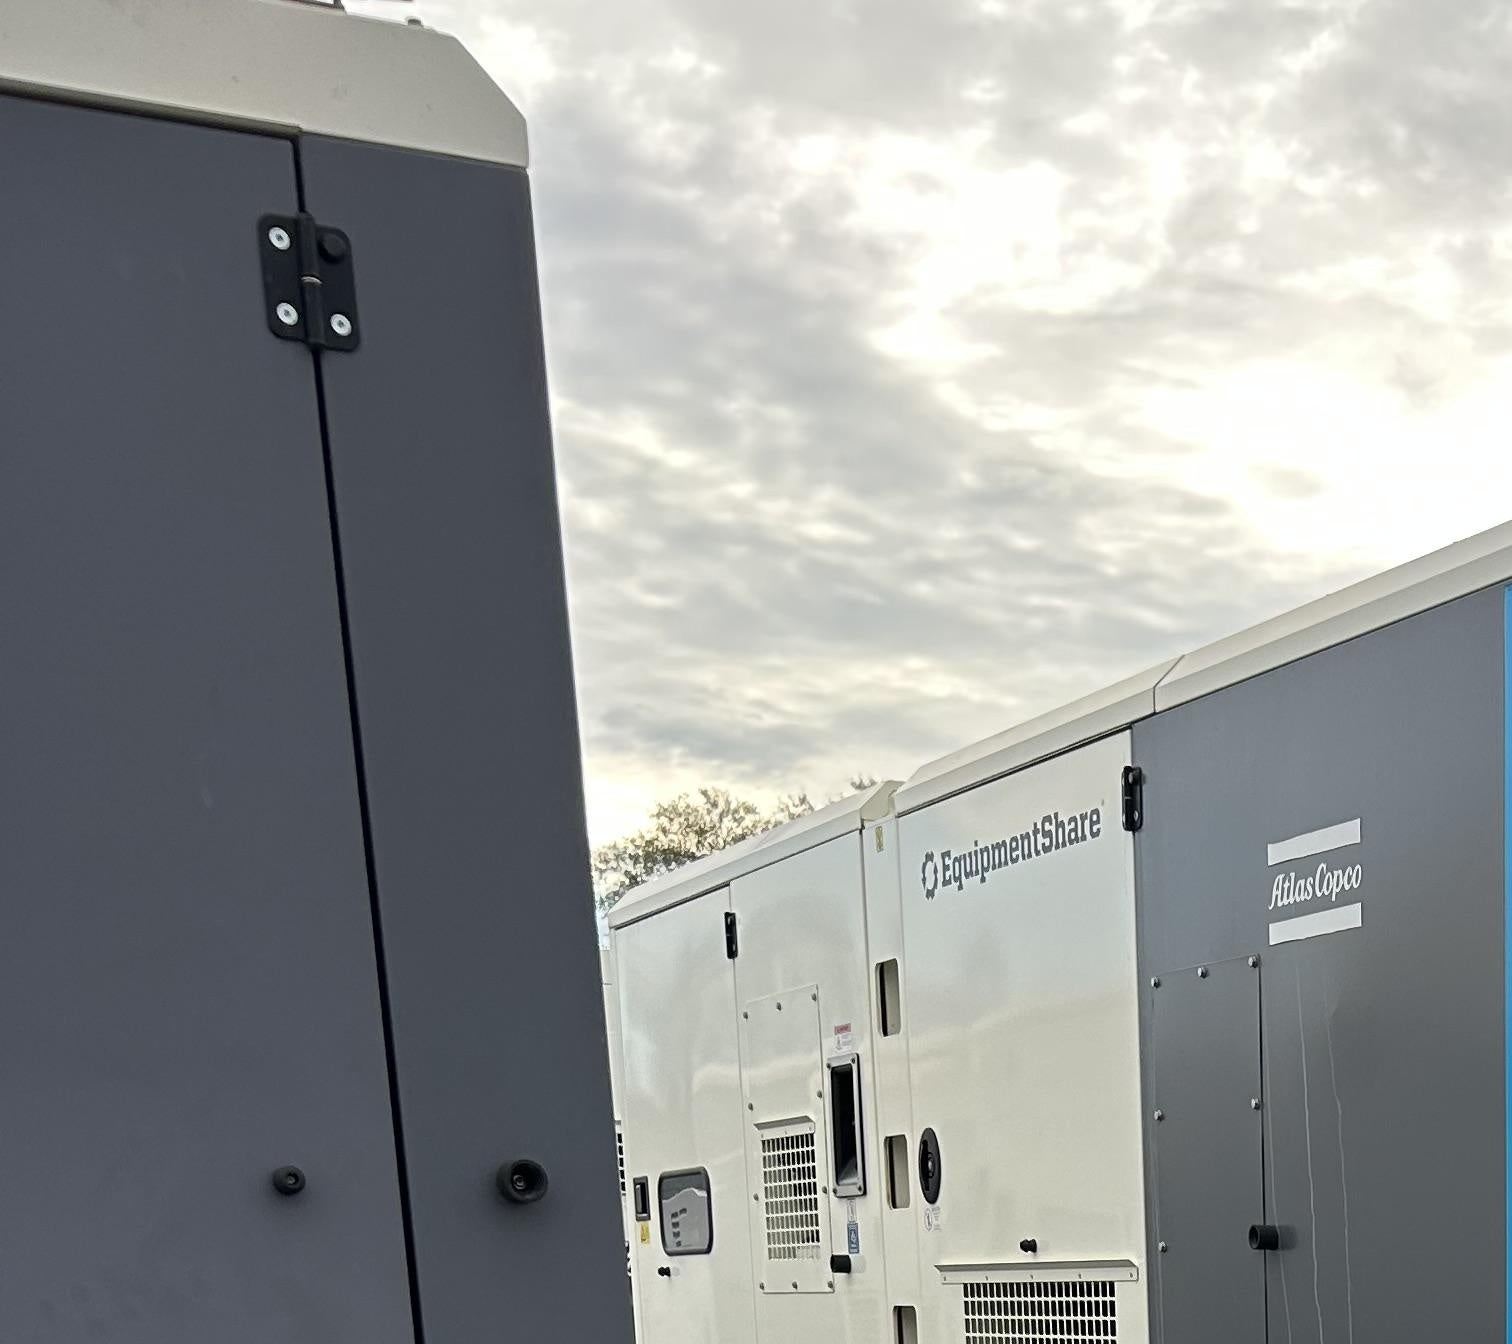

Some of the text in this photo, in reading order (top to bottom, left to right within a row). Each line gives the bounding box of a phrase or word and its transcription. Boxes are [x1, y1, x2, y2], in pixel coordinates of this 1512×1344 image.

[940, 805, 1102, 892] EquipmentShare
[1268, 863, 1362, 910] Atlas Copco
